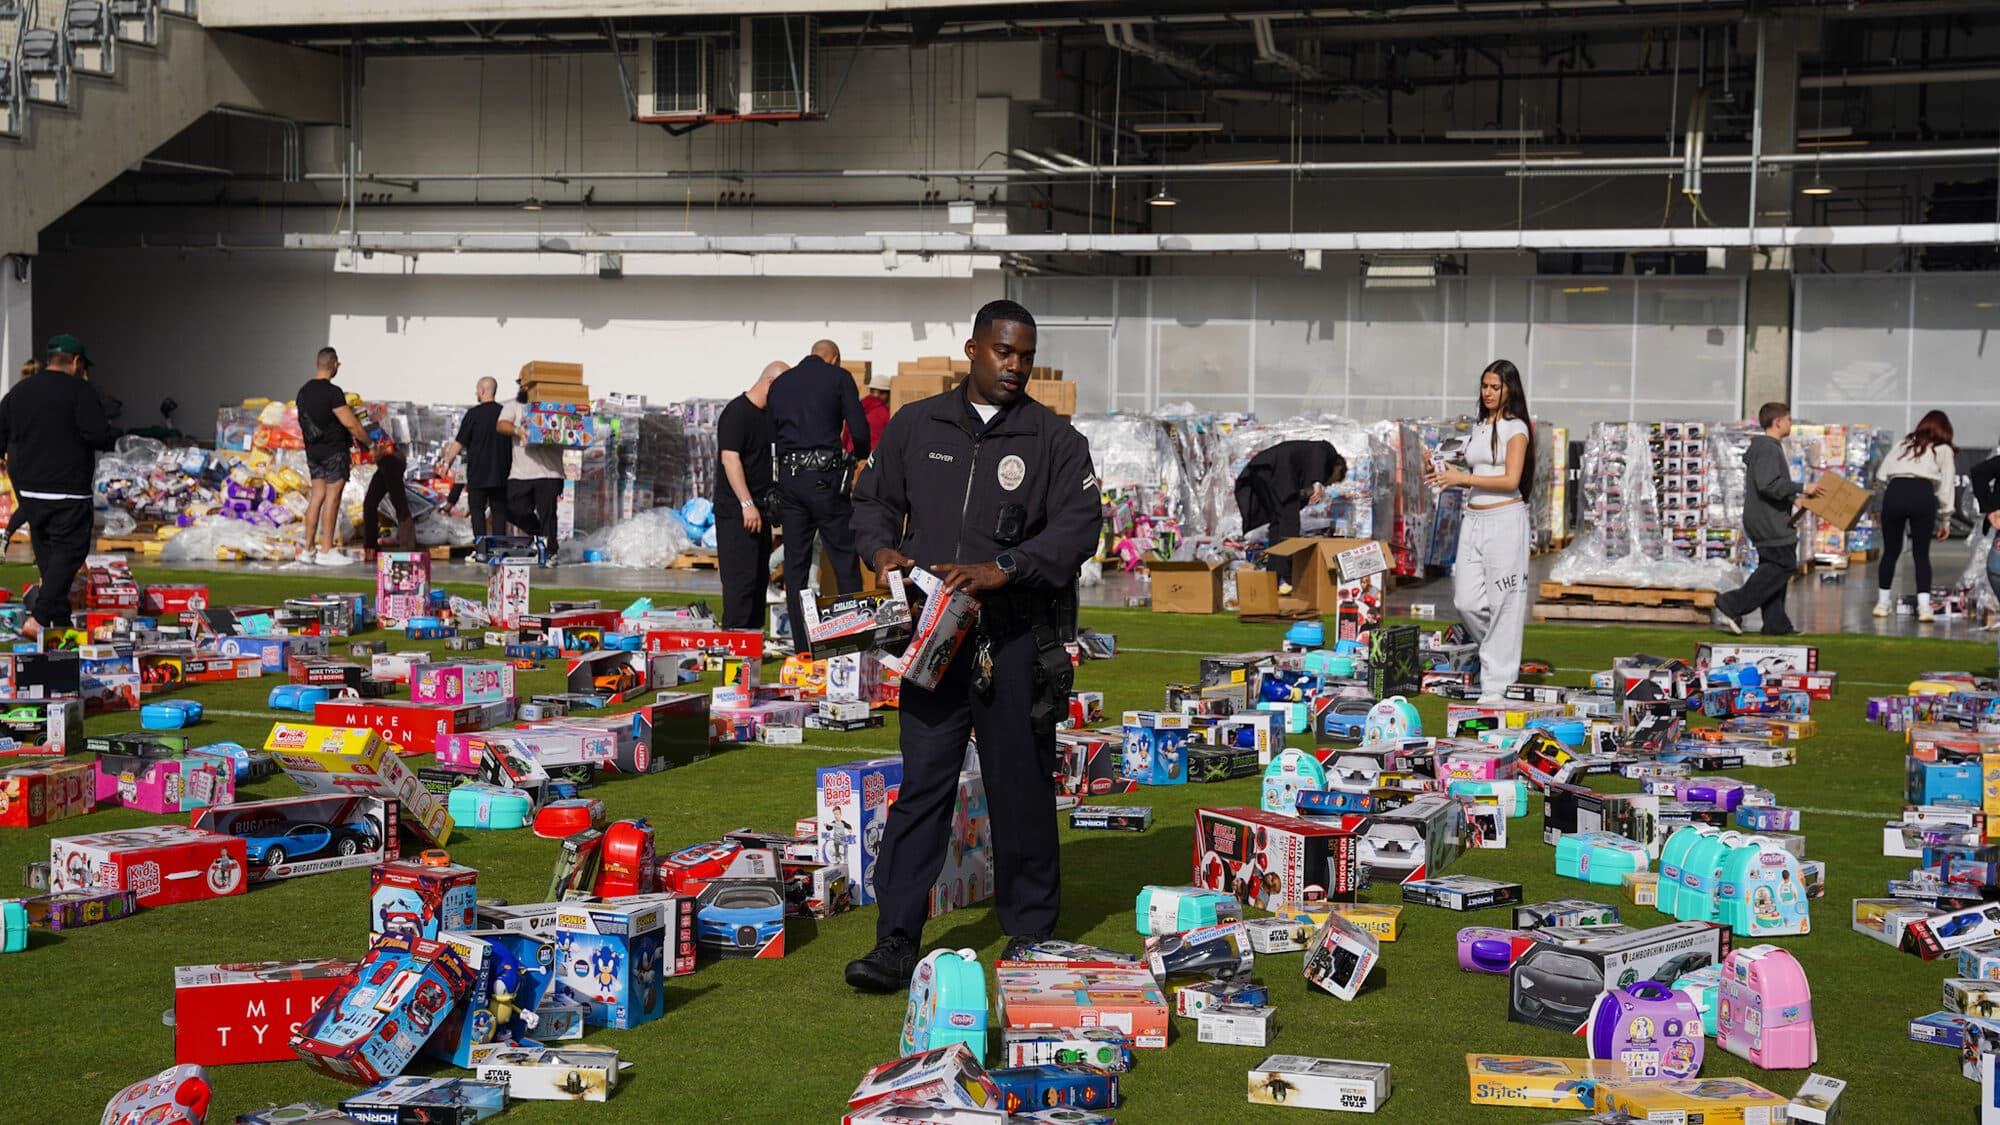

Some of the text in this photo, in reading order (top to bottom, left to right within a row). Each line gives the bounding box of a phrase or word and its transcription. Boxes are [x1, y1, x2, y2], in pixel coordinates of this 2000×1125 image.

[928, 452, 953, 462] GLOVER
[1494, 574, 1516, 592] THE
[832, 599, 858, 612] POLICE
[346, 714, 398, 726] MIKE
[638, 744, 646, 770] BUGATTI
[825, 774, 850, 788] Kid's
[864, 774, 884, 789] Kid's
[826, 786, 850, 800] Band
[865, 787, 884, 802] Band
[236, 818, 280, 834] BUGATTI
[1075, 819, 1108, 827] HORNET
[130, 863, 158, 878] Kid's
[293, 860, 342, 874] BUGATTI CHIRON
[132, 876, 159, 890] Band
[1467, 896, 1494, 906] HORNET
[559, 914, 586, 924] SONIC
[1192, 924, 1241, 943] LAMBORGHINI
[1269, 929, 1288, 937] STAR
[1628, 938, 1694, 962] LAMBORGHINI AVENTADOR
[246, 996, 324, 1018] MIK
[217, 1022, 302, 1046] TYS
[1340, 1095, 1367, 1104] WARS
[349, 1112, 398, 1124] HORNE
